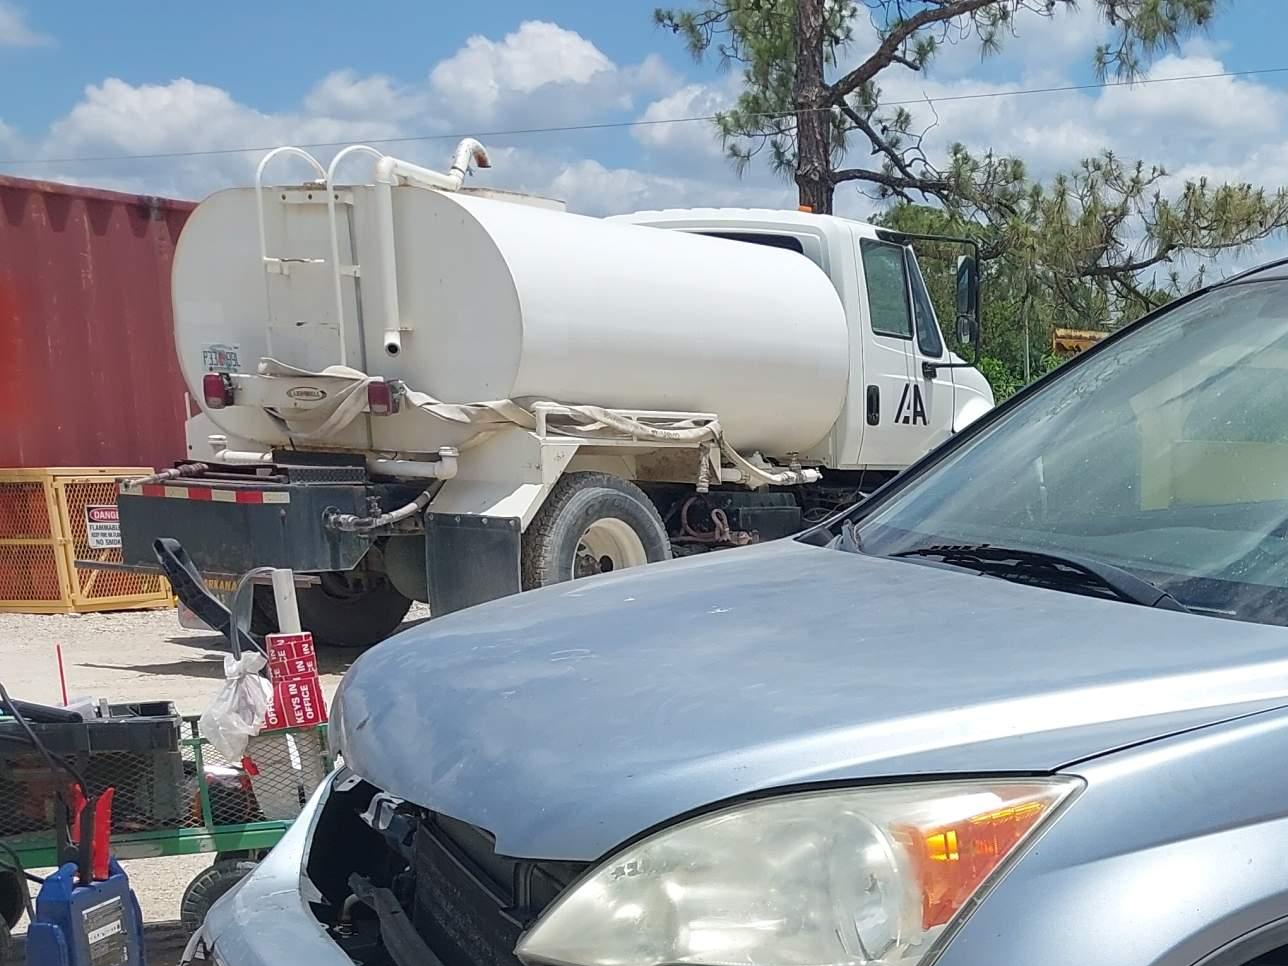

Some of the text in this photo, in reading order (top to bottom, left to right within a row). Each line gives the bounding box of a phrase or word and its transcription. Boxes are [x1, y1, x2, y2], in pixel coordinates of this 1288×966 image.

[93, 510, 119, 519] DANGE
[295, 660, 306, 672] IN
[266, 697, 279, 725] OFFIC
[288, 683, 305, 724] KEYS IN
[300, 685, 314, 719] OFFICE
